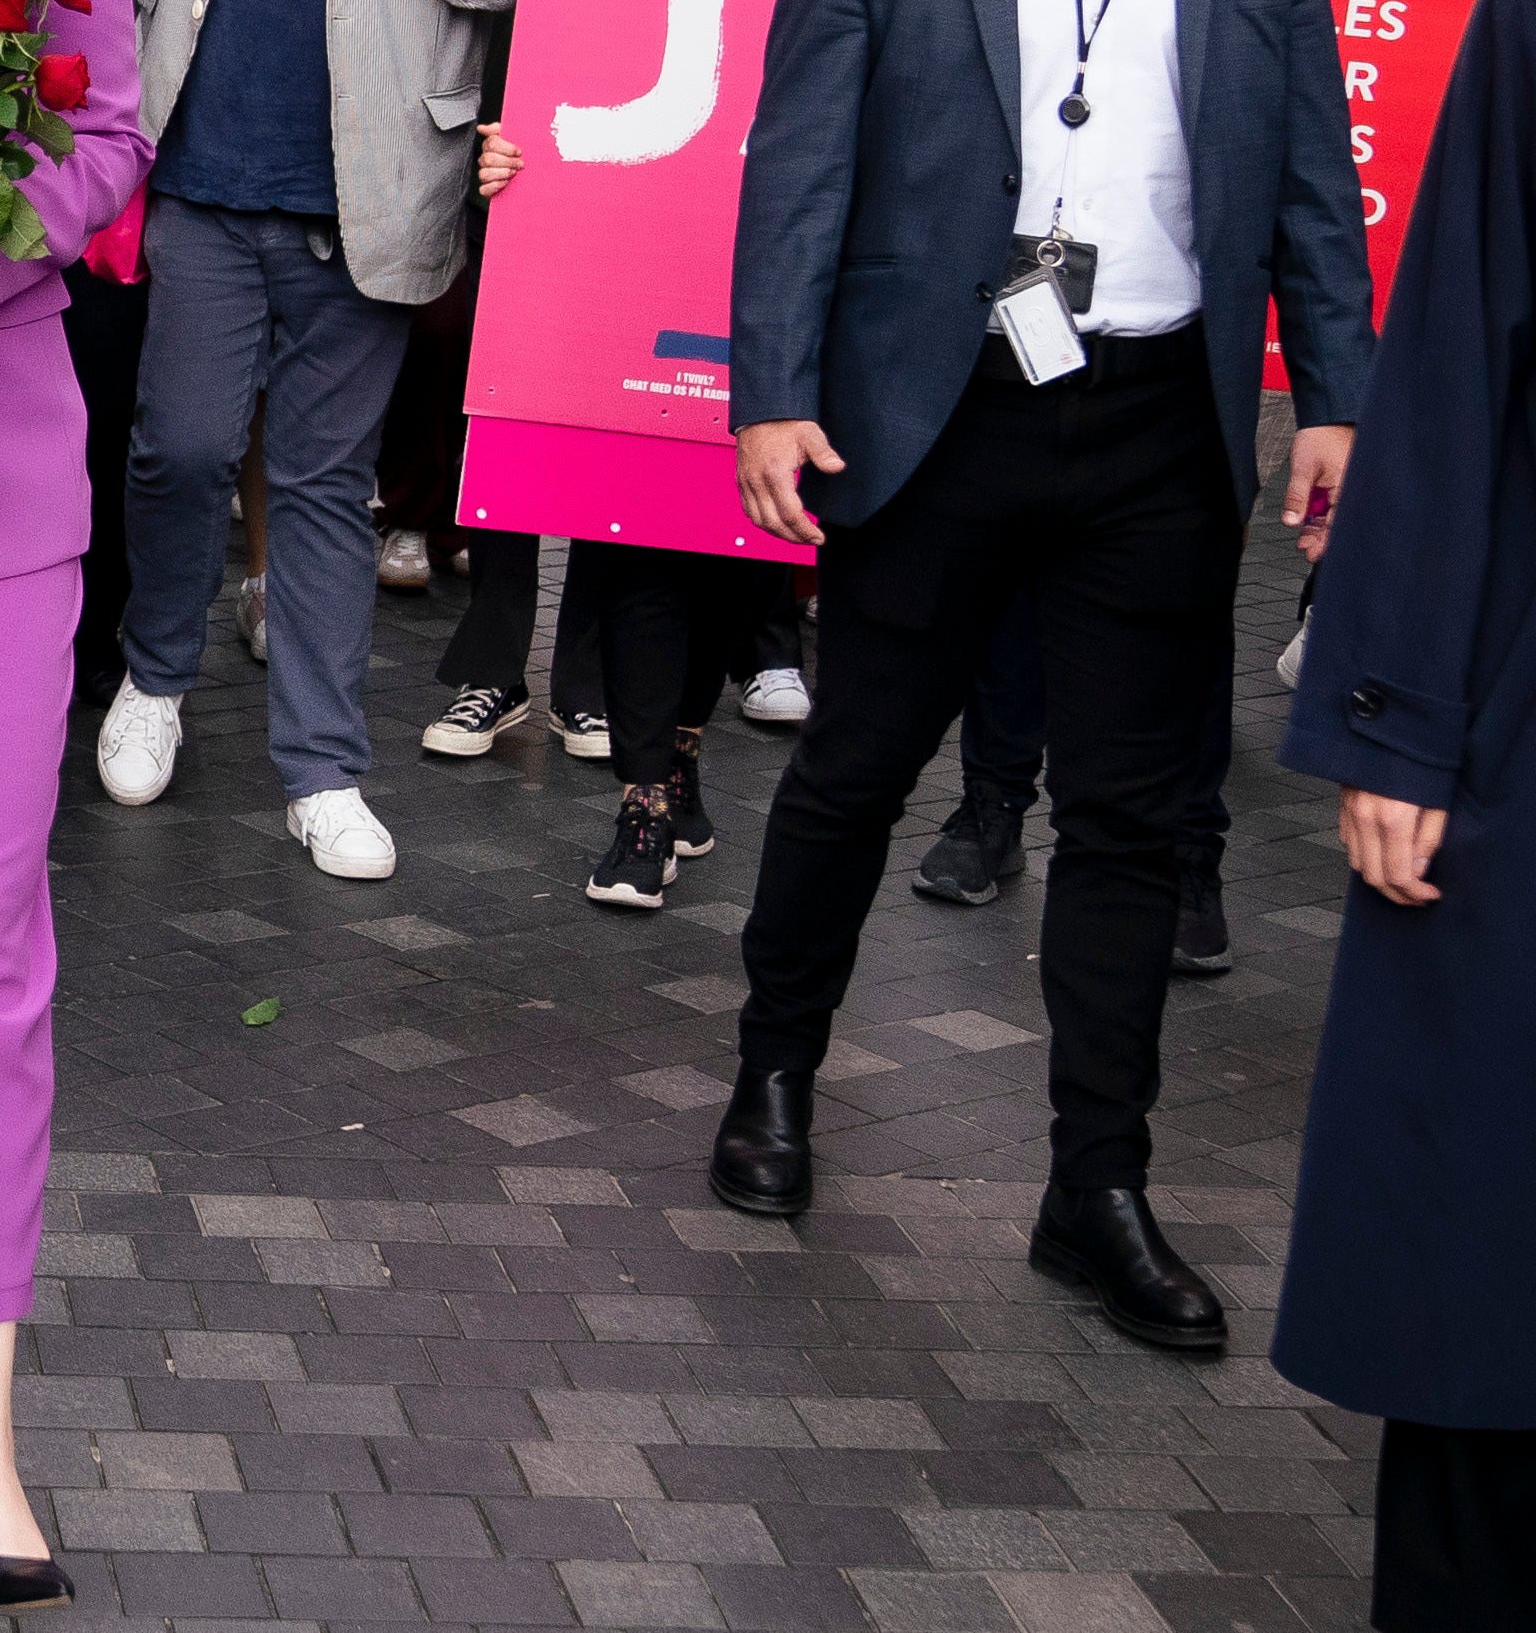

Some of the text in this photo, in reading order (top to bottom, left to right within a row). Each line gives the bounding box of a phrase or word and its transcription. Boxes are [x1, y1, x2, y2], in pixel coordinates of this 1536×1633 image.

[683, 372, 716, 386] TVIVL?
[623, 378, 649, 391] CHAT
[649, 382, 672, 394] MED
[673, 384, 687, 396] OS
[688, 384, 702, 398] PÅ
